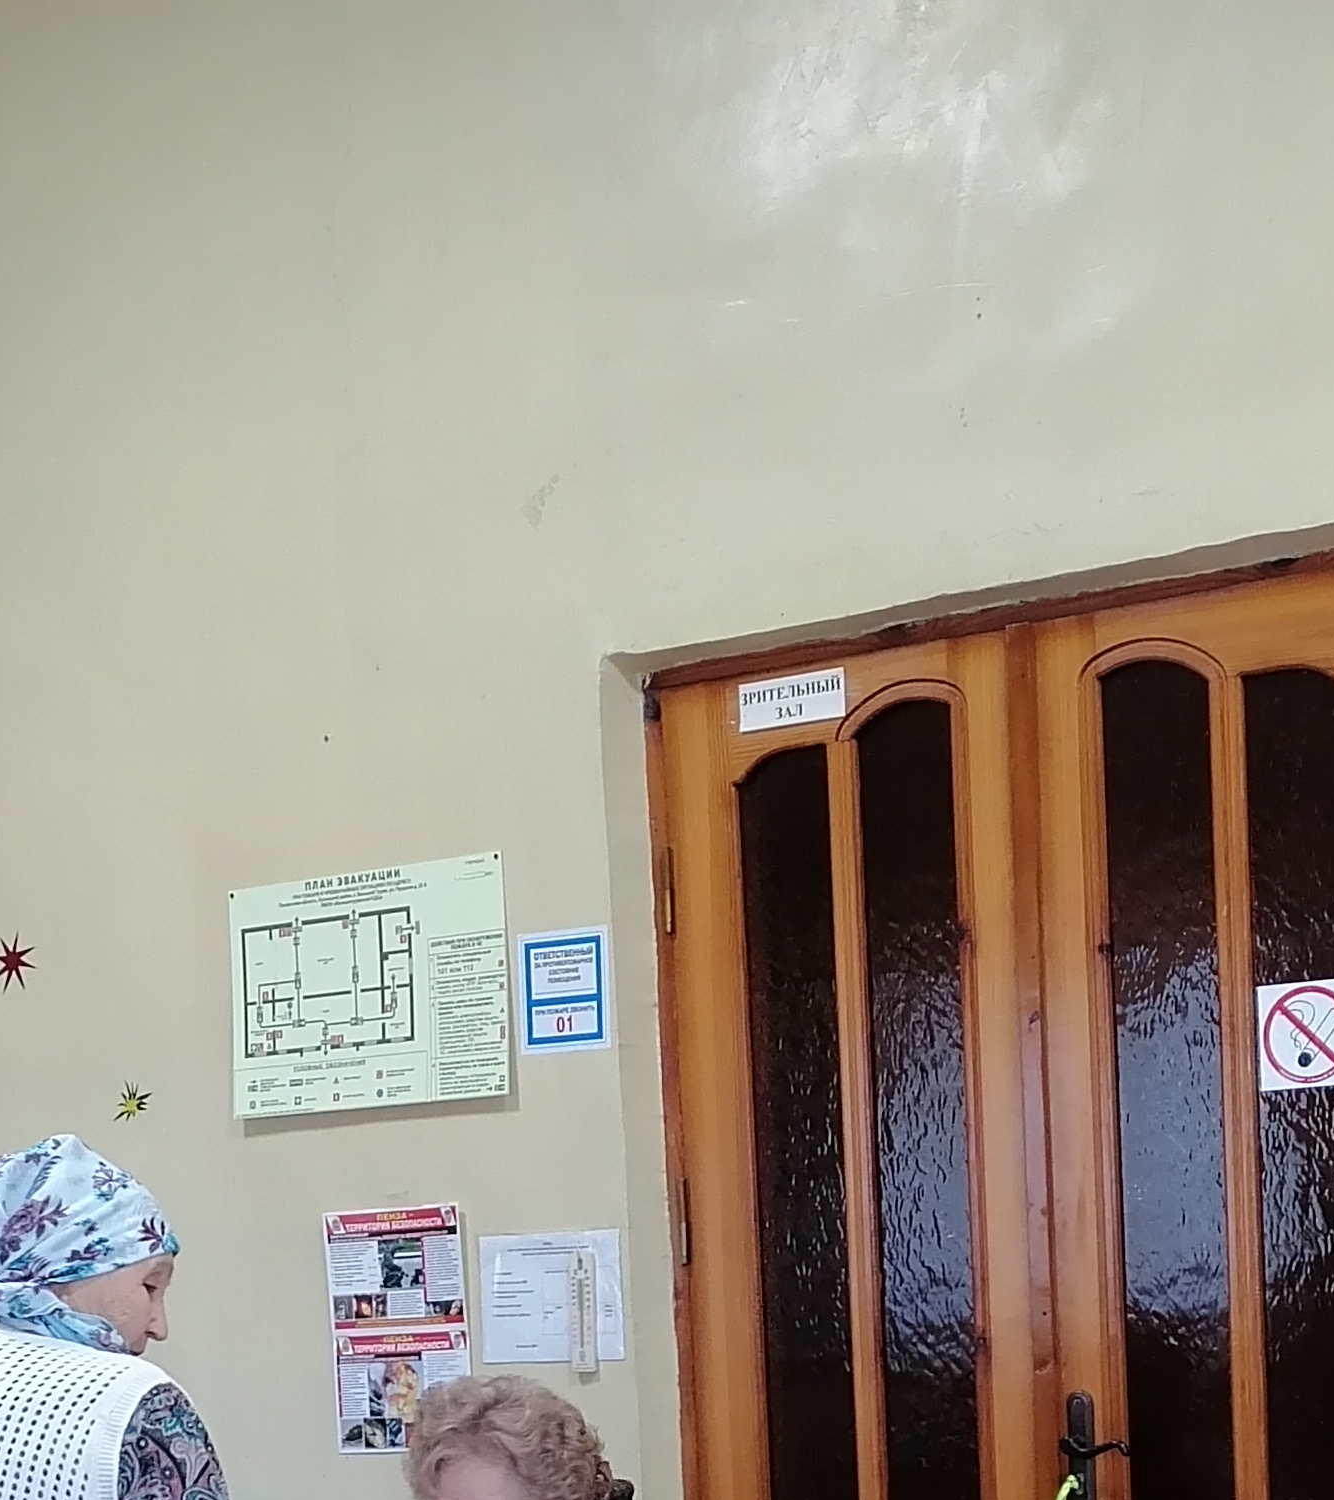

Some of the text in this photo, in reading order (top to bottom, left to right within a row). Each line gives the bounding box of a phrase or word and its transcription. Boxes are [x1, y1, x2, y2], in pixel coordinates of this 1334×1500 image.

[741, 675, 841, 706] ЗРИТЕЛЬНЫЙ
[775, 703, 803, 720] ЗАЛ
[304, 868, 401, 891] ПЛАН ЭВАКУАЦИИ
[556, 1014, 573, 1033] 01
